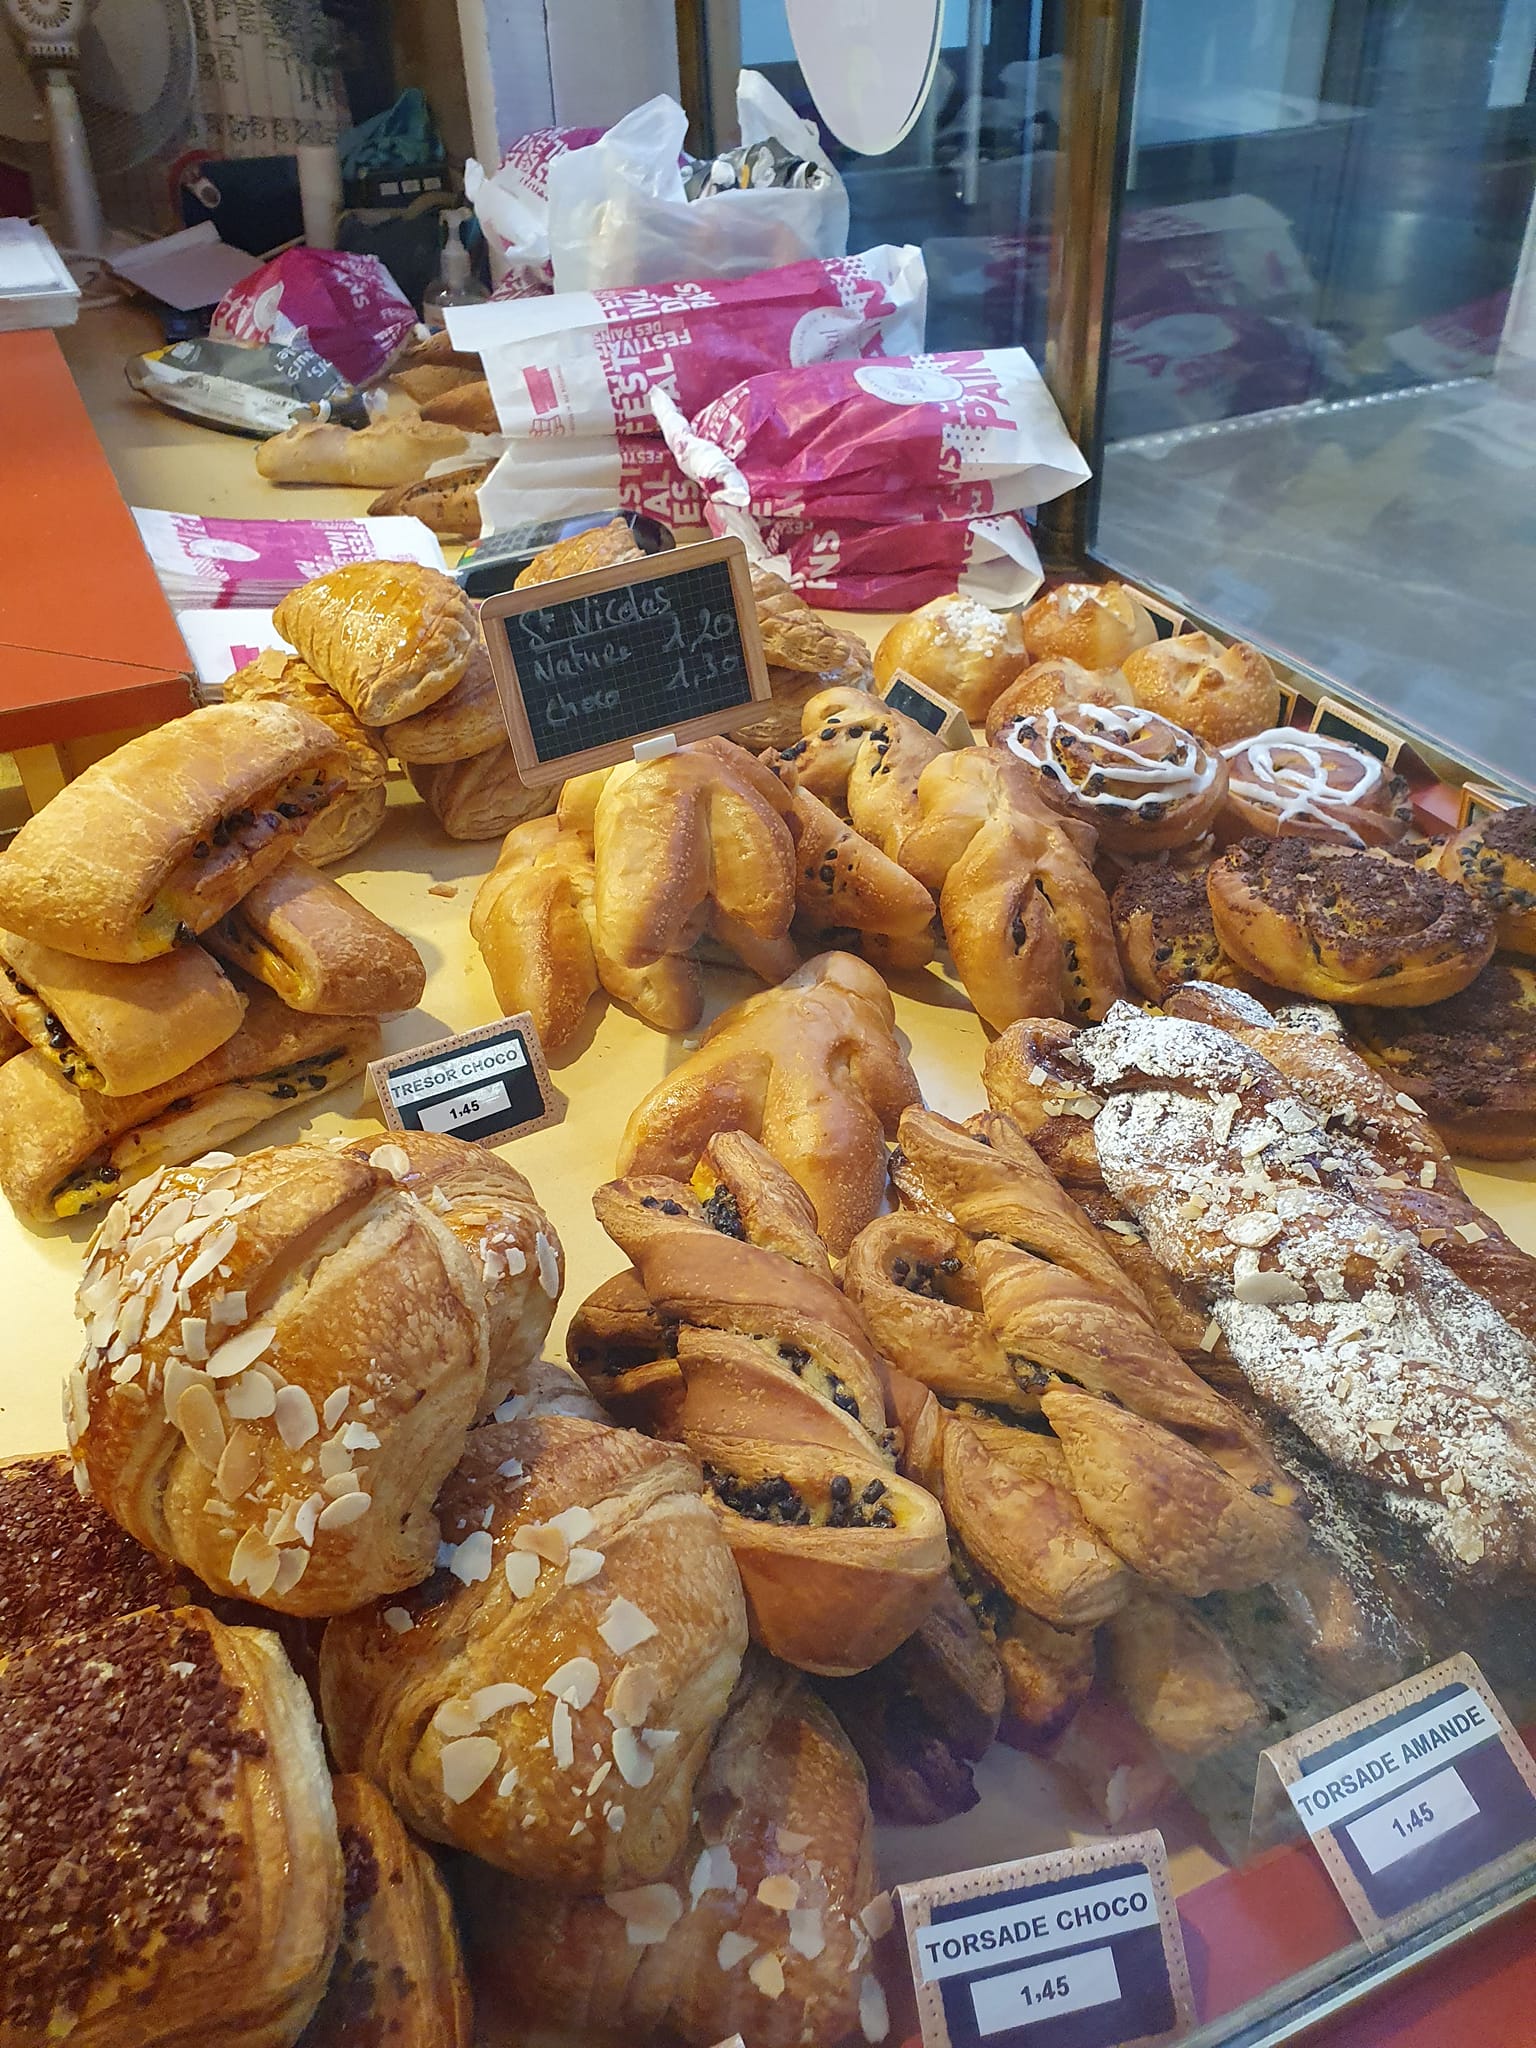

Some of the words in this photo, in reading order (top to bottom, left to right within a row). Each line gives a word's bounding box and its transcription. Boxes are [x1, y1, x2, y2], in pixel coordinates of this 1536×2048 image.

[595, 327, 693, 359] FESTIVAL
[391, 1068, 457, 1099] TRESOR
[461, 1050, 518, 1076] CHOCO
[450, 1100, 480, 1120] 1,45
[1297, 1752, 1401, 1817] TORSADE
[1401, 1705, 1486, 1764] AMANDE
[1391, 1802, 1435, 1838] 1,45
[925, 1916, 1050, 1963] TORSADE
[1056, 1892, 1148, 1931] CHOCO
[1020, 1975, 1070, 2006] 1,45
